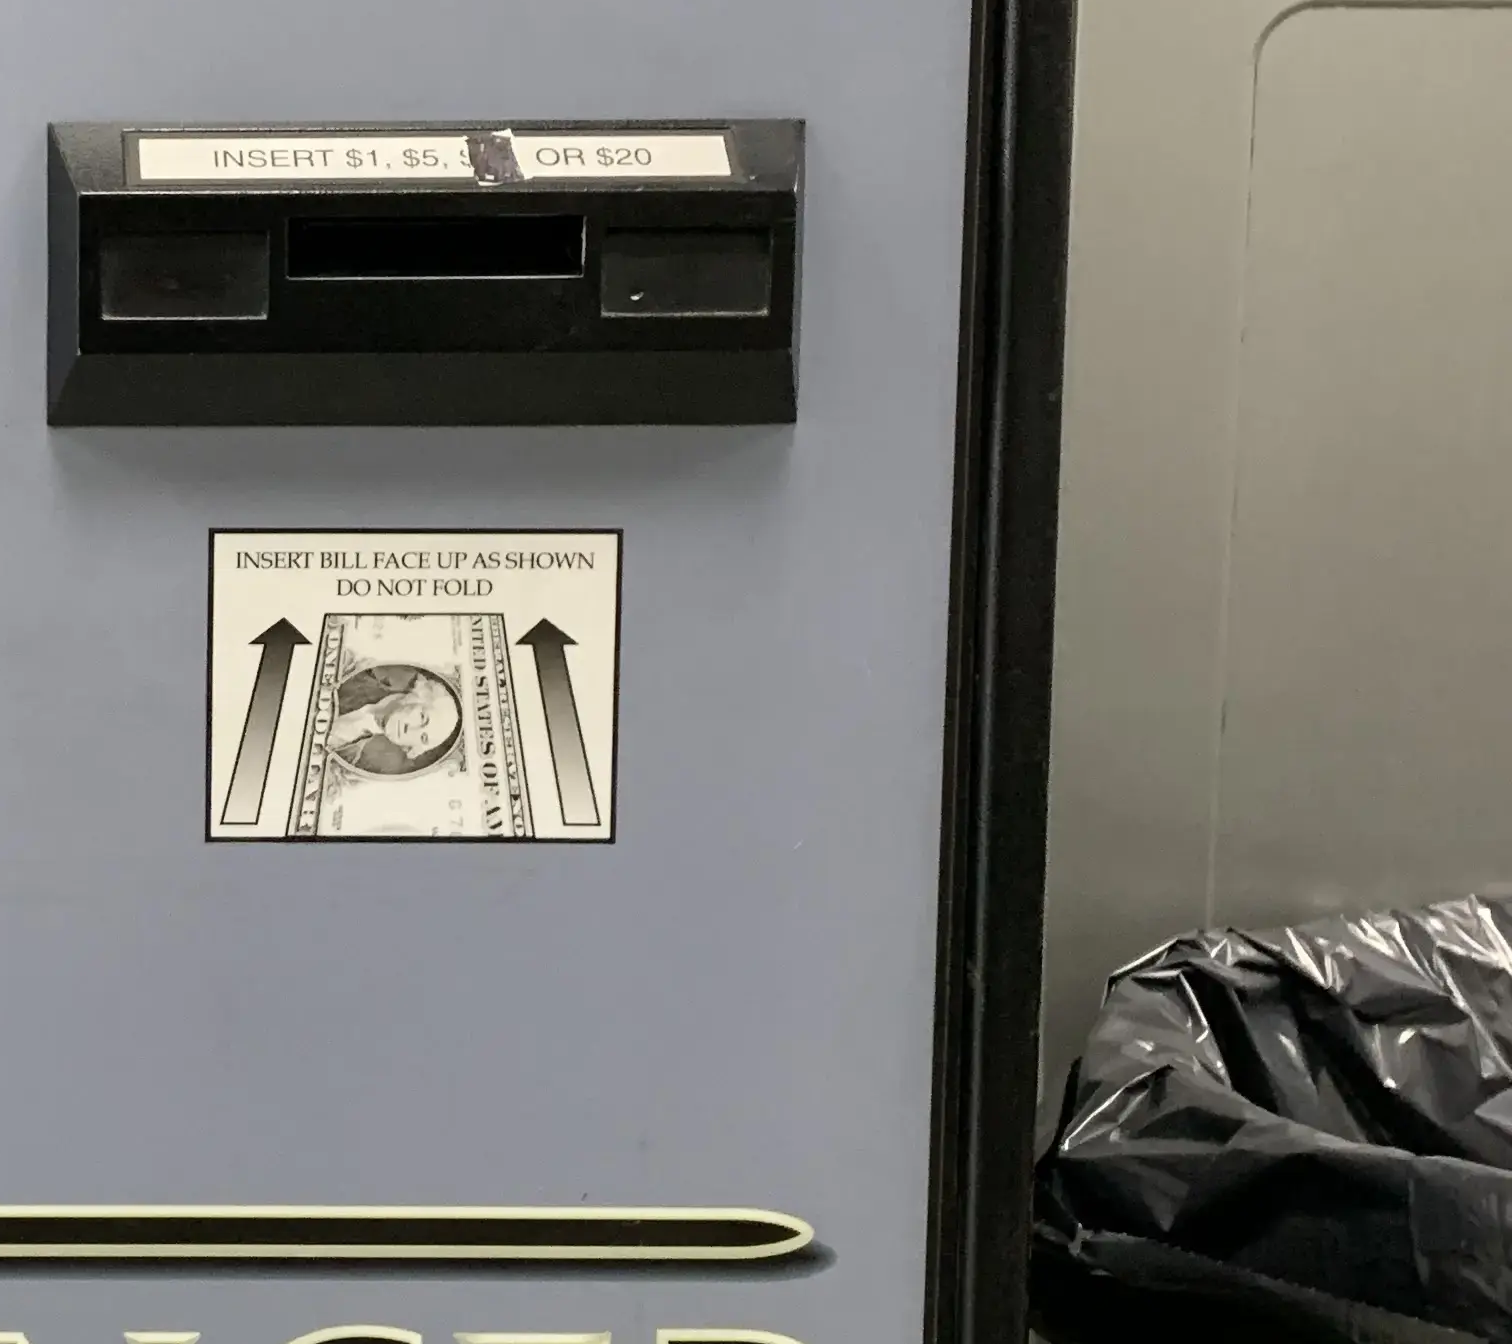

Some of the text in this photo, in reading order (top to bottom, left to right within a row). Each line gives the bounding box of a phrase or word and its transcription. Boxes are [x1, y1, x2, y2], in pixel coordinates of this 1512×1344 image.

[213, 149, 334, 168] INSERT
[345, 148, 392, 169] $1,
[402, 148, 449, 169] $5,
[535, 147, 587, 167] OR
[595, 146, 653, 168] $20
[235, 552, 596, 570] INSERT BILL FACE UP AS SHOWN
[336, 578, 494, 597] DO NOT FOLD
[475, 675, 494, 756] STATES
[482, 762, 498, 796] OF
